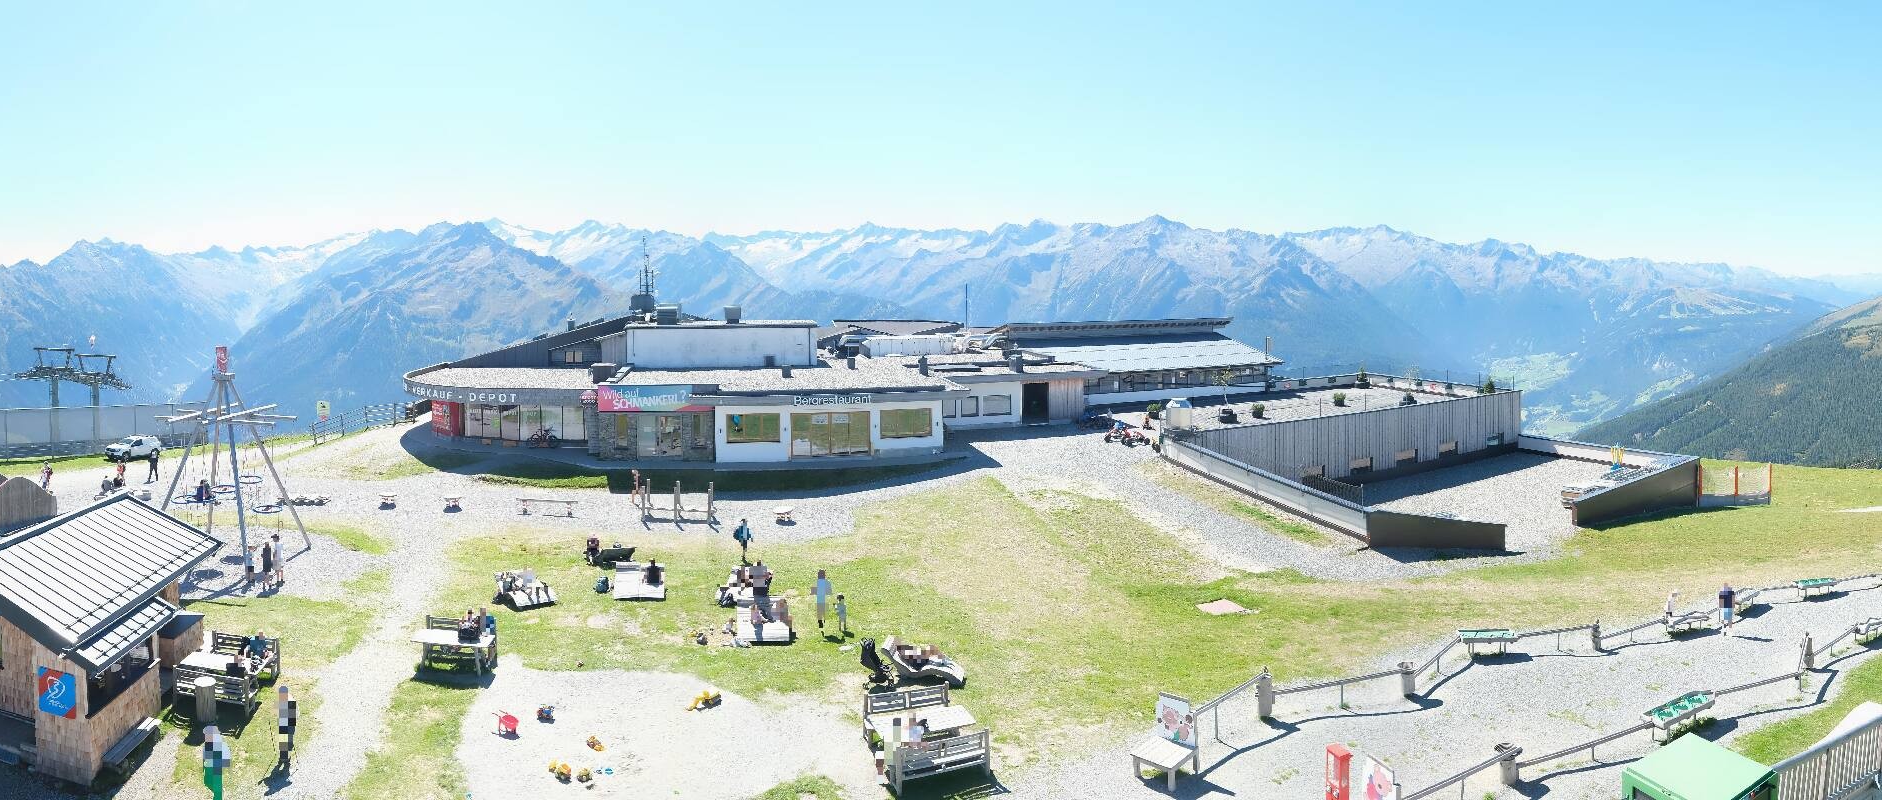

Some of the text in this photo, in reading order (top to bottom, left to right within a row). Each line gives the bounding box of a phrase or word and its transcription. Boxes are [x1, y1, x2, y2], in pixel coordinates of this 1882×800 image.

[412, 387, 453, 399] VERKAUF
[469, 393, 517, 403] DEPOT
[602, 388, 640, 400] Wild auf
[794, 394, 872, 406] Bergrestaurant
